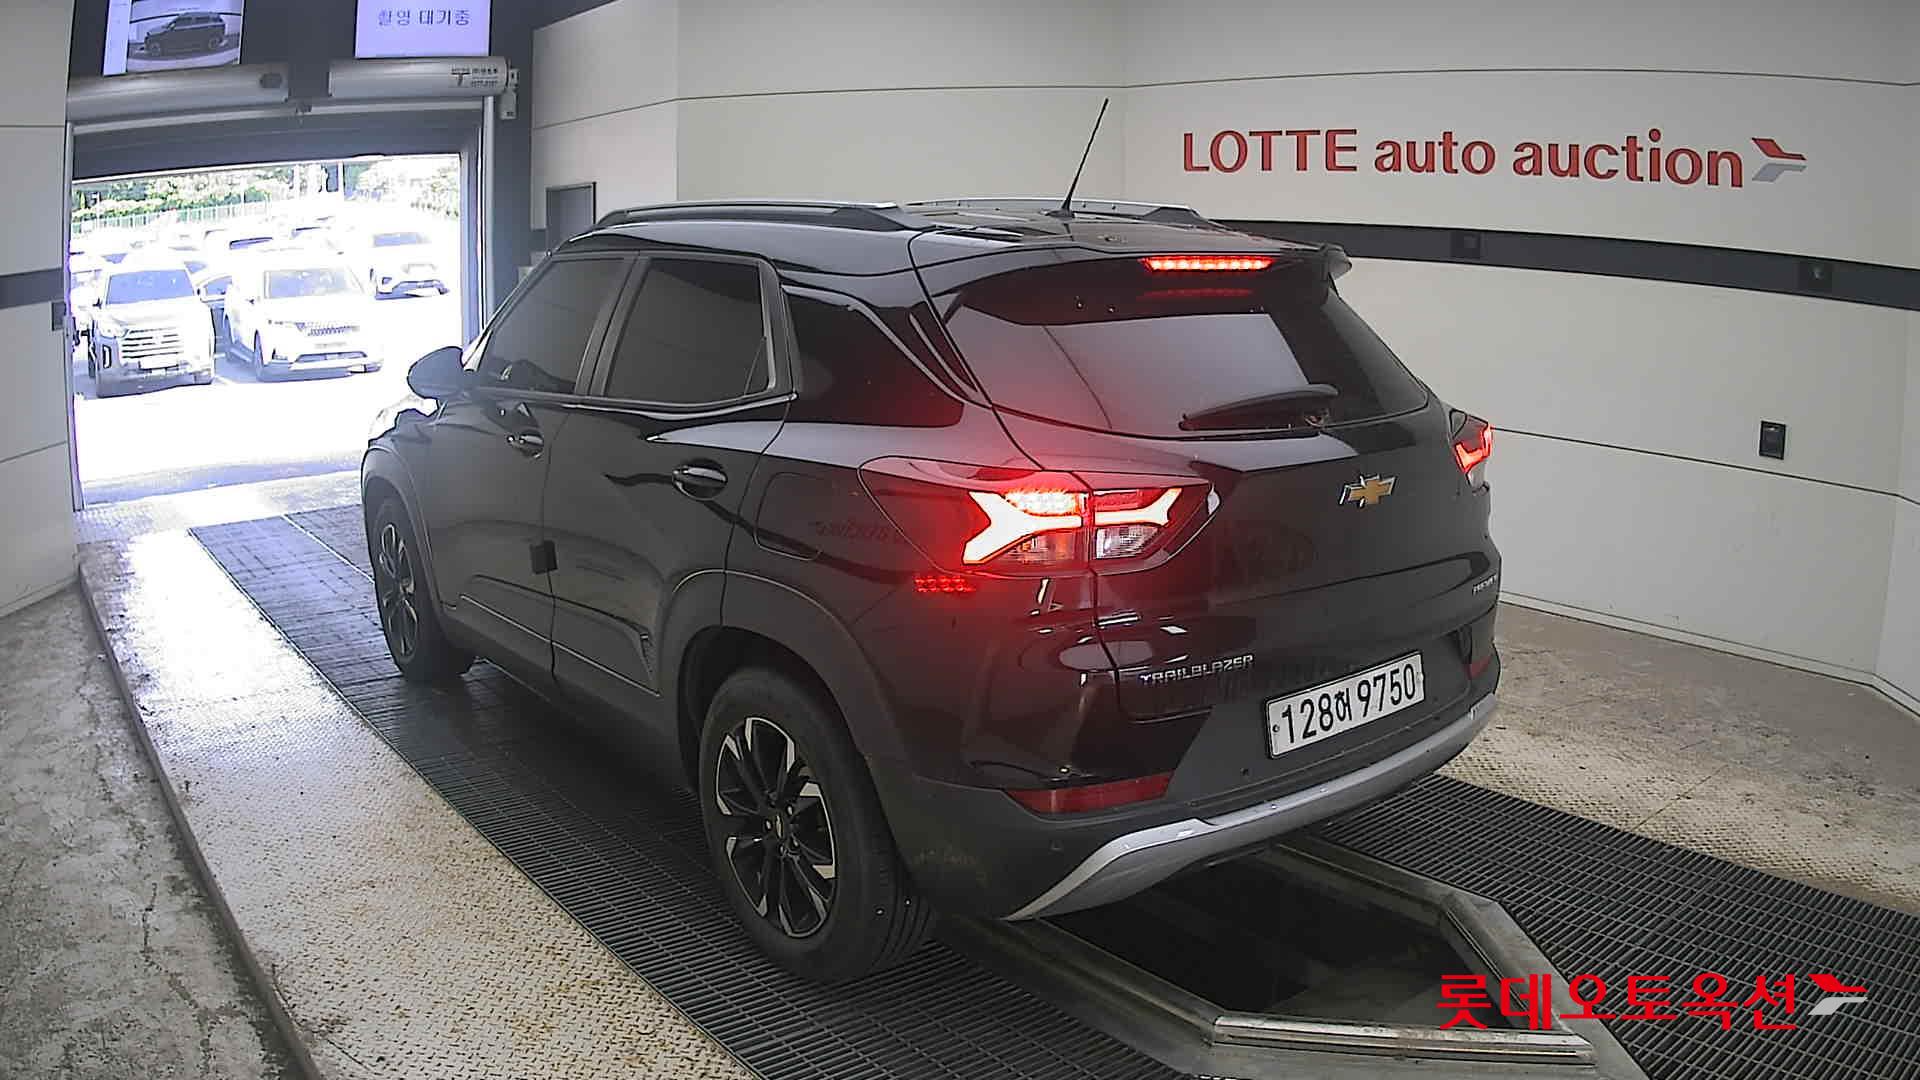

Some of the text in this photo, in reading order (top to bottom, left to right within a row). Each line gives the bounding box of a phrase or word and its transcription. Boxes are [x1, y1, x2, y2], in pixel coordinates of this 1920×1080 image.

[418, 8, 470, 26] 대기중
[1183, 128, 1744, 188] LOTTE auto auction
[1139, 654, 1255, 684] TRAILBLAZER
[1281, 663, 1416, 744] 128허 9750
